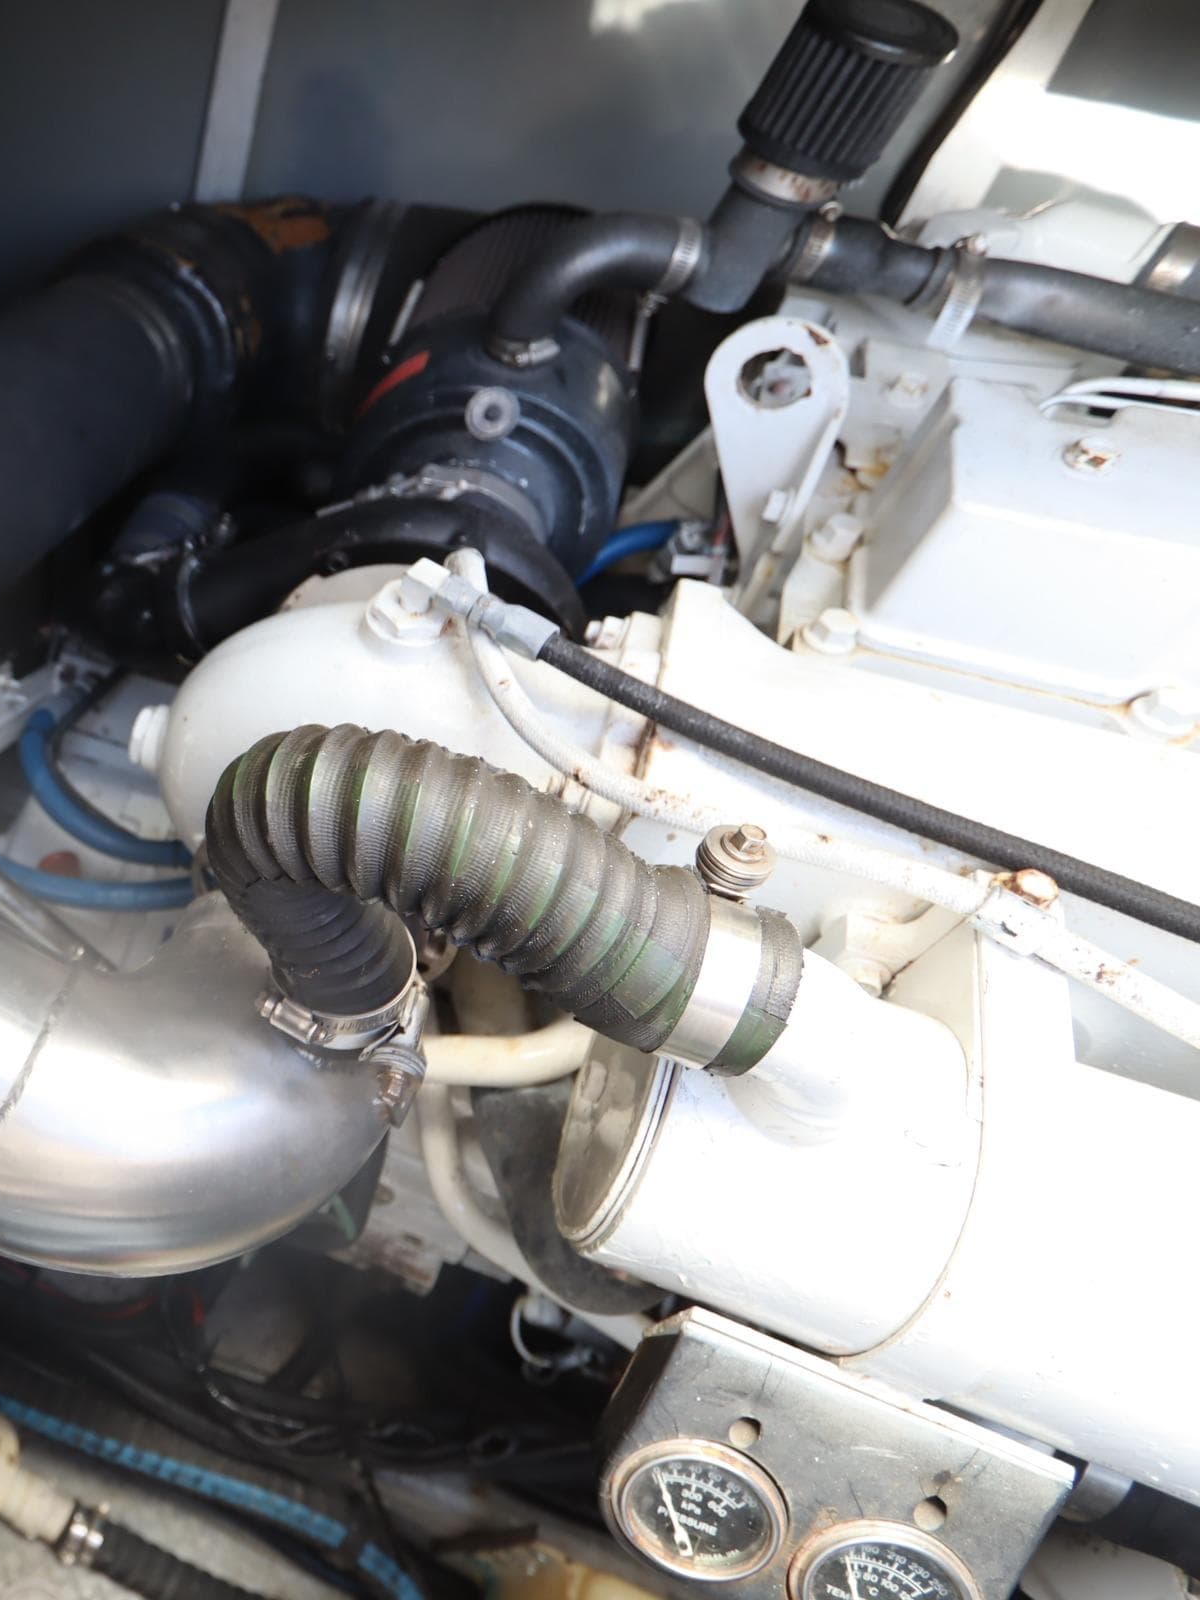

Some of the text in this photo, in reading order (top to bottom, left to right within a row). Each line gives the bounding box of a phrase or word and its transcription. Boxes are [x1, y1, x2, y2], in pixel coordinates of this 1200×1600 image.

[680, 1500, 702, 1515] kPa
[657, 1505, 718, 1536] PSSURE
[908, 1562, 930, 1579] 230
